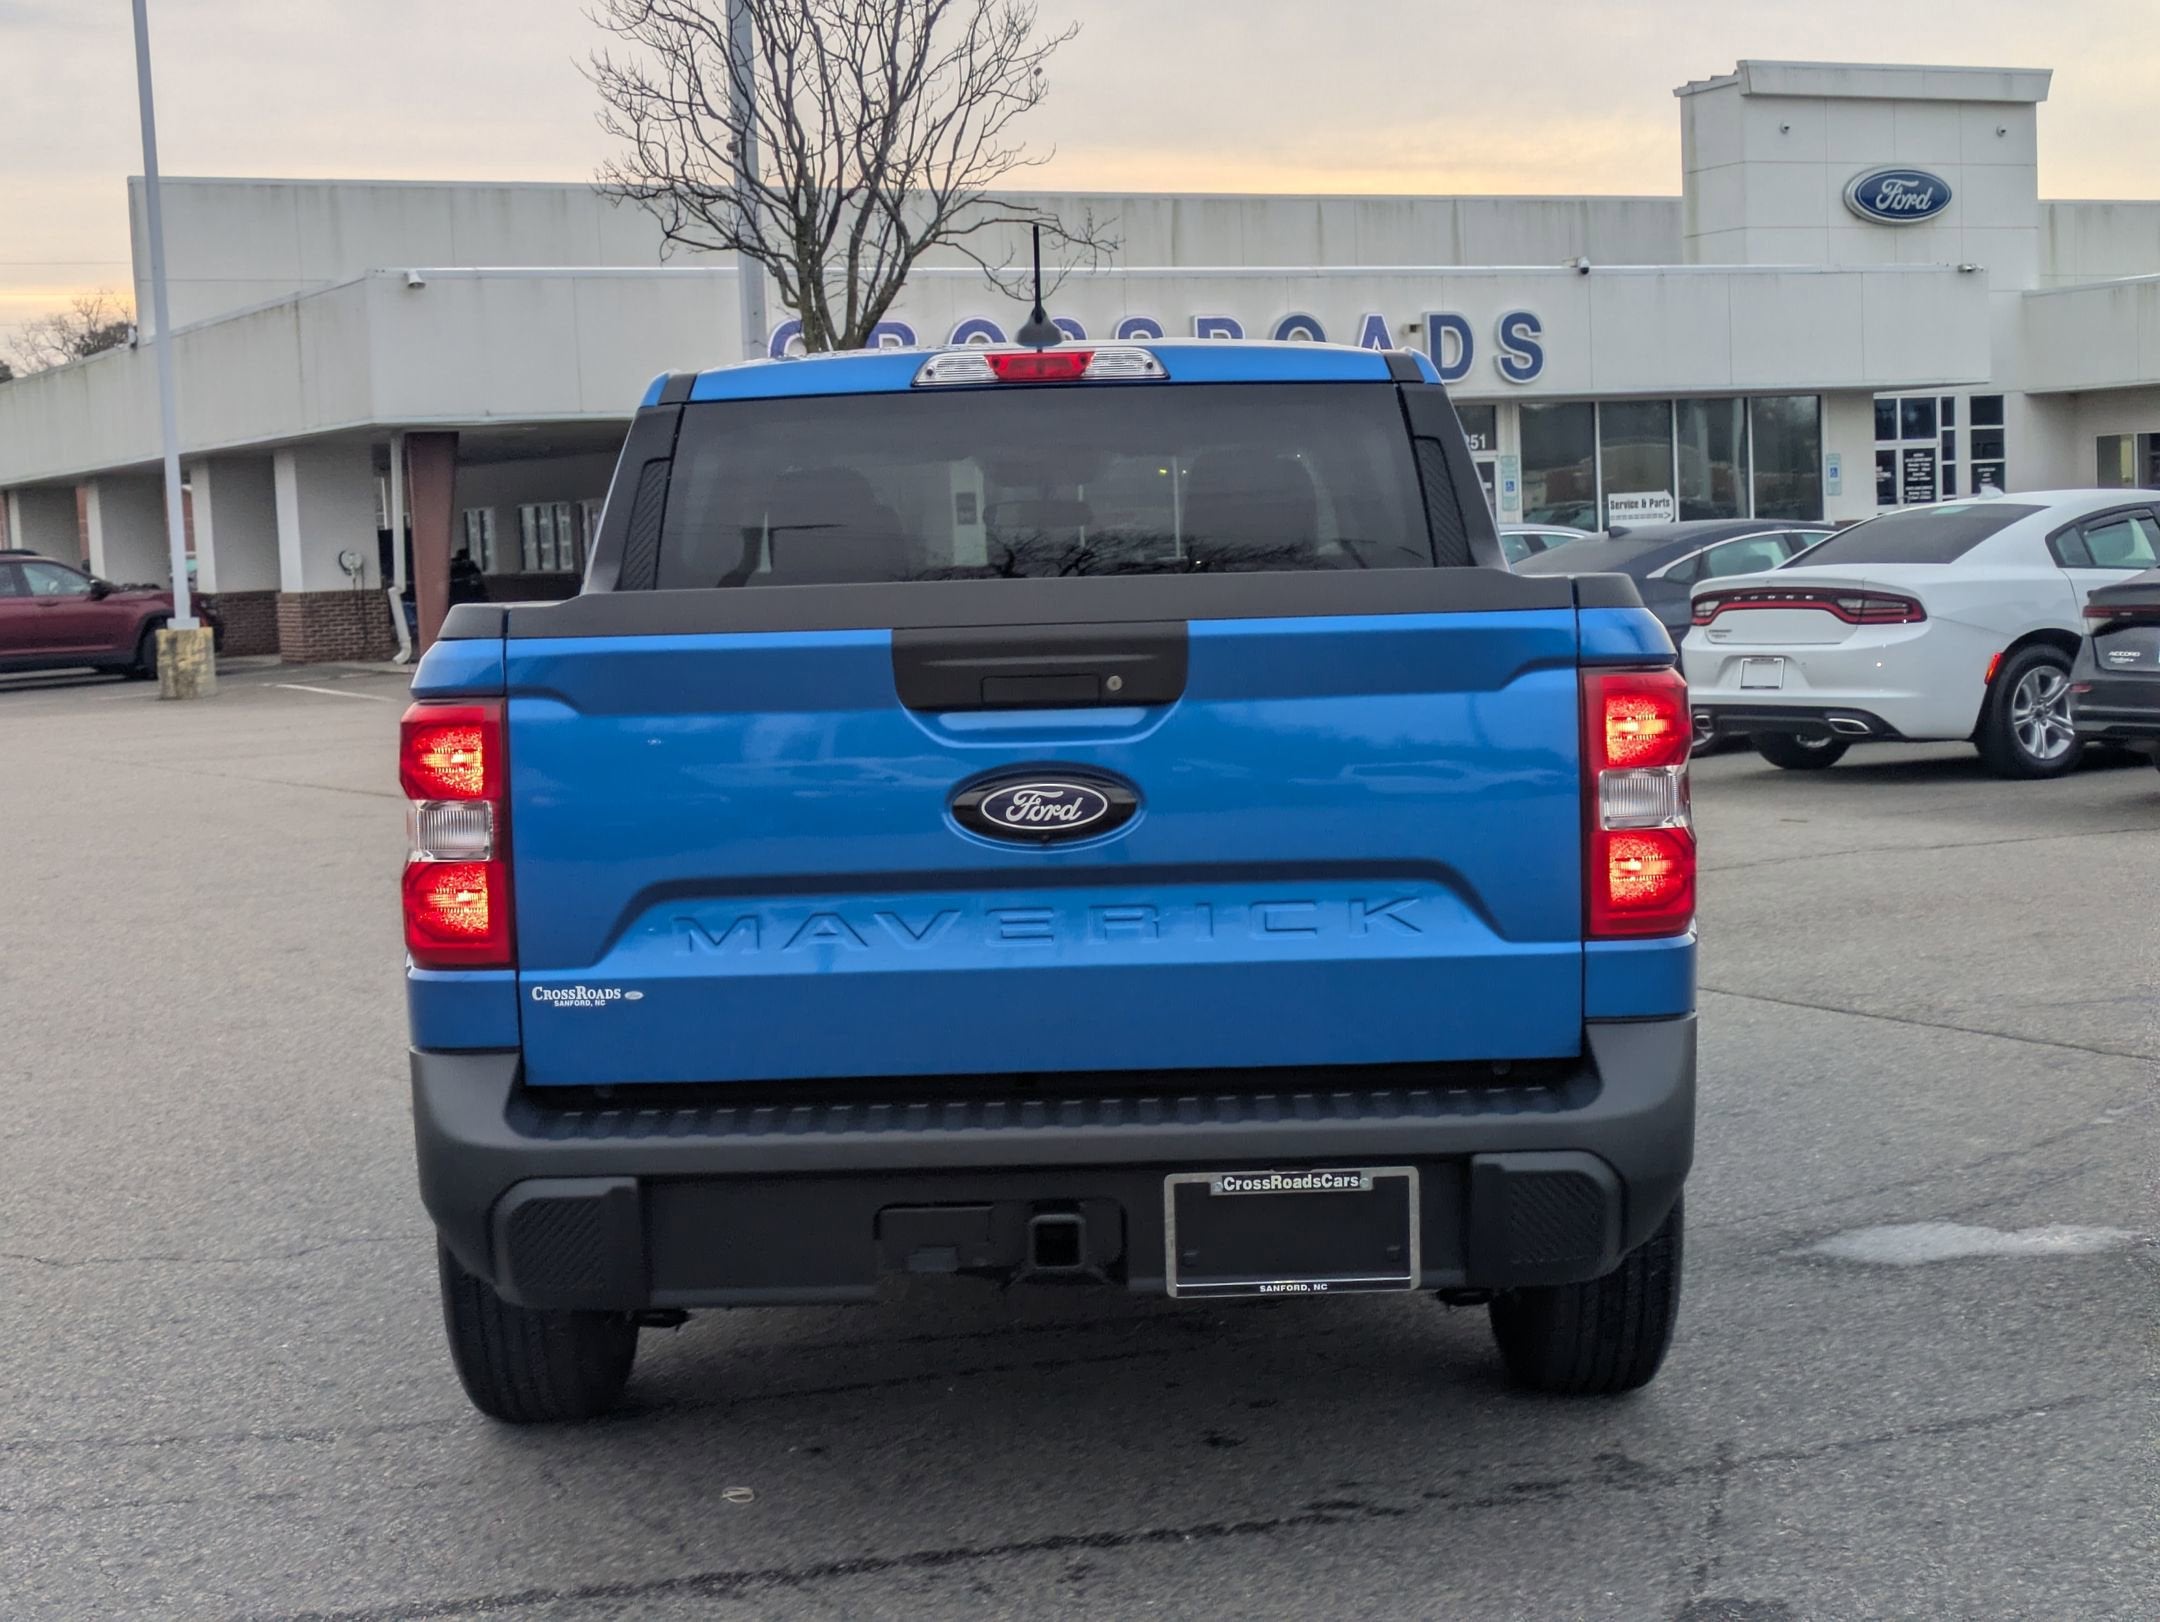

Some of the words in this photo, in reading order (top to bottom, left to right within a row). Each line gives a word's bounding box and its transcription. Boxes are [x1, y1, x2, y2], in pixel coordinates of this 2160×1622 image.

[1876, 179, 1933, 210] Ford
[1610, 500, 1639, 510] Service
[1641, 498, 1647, 509] &
[1649, 498, 1670, 508] Parts
[1006, 790, 1083, 822] Ford
[672, 897, 1423, 955] MAVERICK
[1223, 1173, 1360, 1191] CrossRoadsCars
[1260, 1284, 1311, 1292] SANFORD,
[1314, 1283, 1328, 1291] NC
